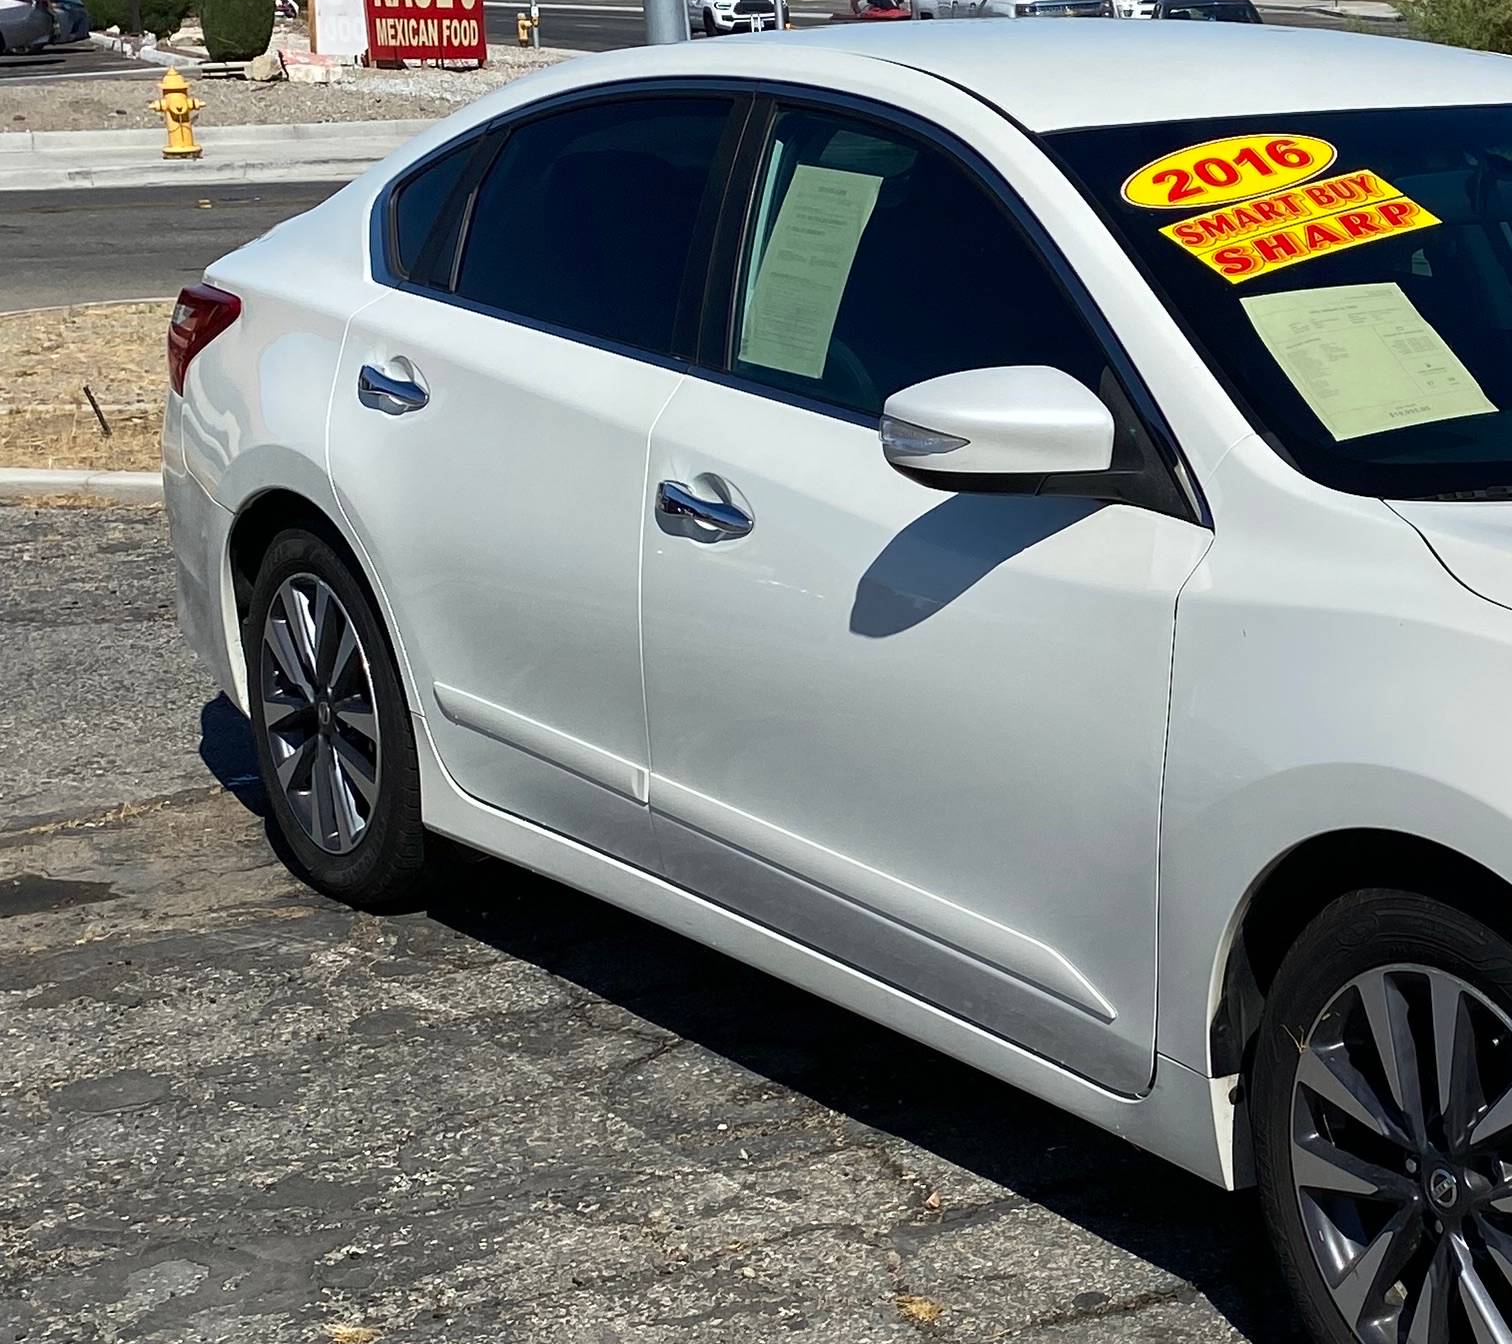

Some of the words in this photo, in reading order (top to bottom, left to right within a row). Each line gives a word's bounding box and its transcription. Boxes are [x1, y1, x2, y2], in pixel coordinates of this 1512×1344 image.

[375, 17, 439, 47] MEXICAN
[442, 18, 479, 47] FOOD
[1152, 138, 1313, 204] 2016
[1172, 193, 1312, 248] SMART
[1304, 173, 1385, 212] BUY
[1211, 196, 1421, 277] SHARP
